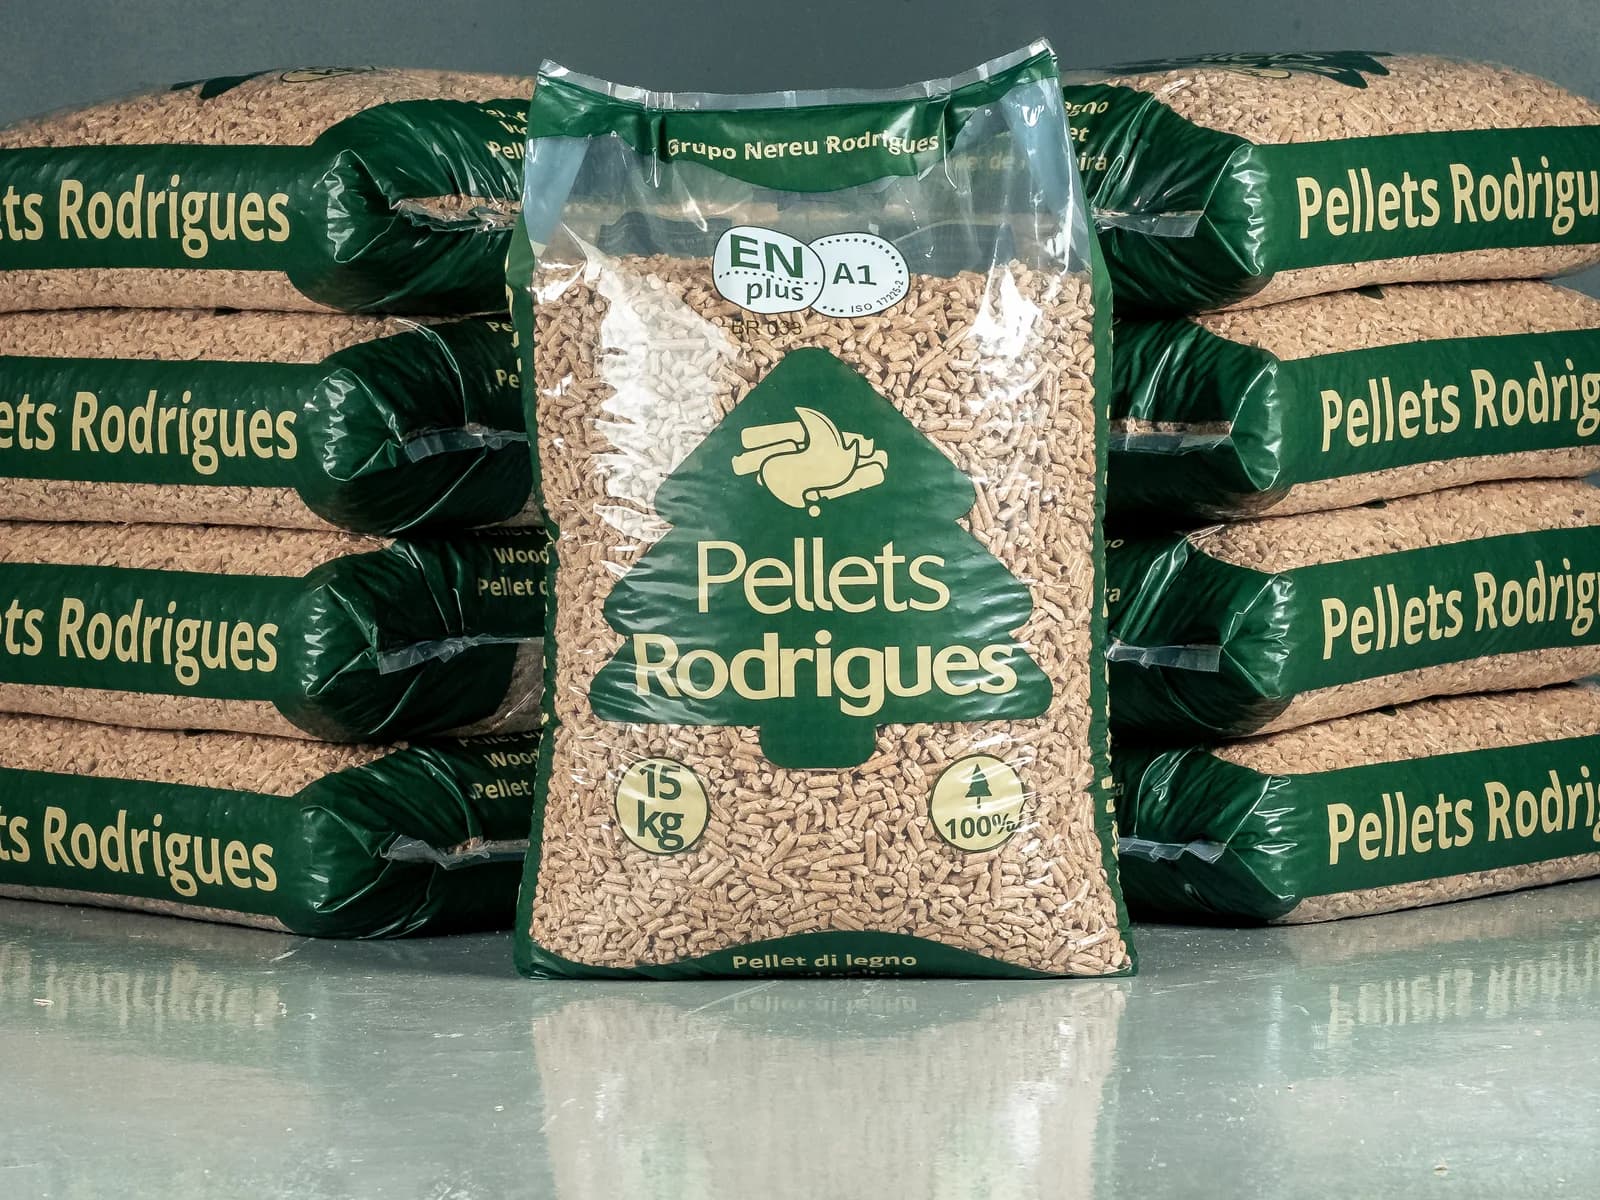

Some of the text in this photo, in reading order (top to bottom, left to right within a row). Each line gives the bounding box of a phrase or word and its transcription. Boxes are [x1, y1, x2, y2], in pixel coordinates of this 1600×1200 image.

[668, 131, 940, 160] Grupo Nereu Rodrigues
[0, 174, 290, 259] ts Rodrigues
[1296, 156, 1599, 239] Pellets Rodrigu
[730, 234, 804, 279] EN
[832, 262, 877, 286] A1
[746, 278, 804, 305] plus
[851, 303, 873, 313] ISO
[732, 320, 760, 335] BR
[1321, 359, 1600, 452] Pellets Rodrig
[0, 389, 298, 475] ets Rodrigues
[477, 577, 534, 596] Pellet
[697, 537, 951, 614] Pellets
[1322, 559, 1600, 660] Pellets Rodrig
[0, 598, 279, 686] ts Rodrigues
[633, 629, 1018, 717] Rodrigues
[639, 763, 682, 800] 15
[637, 799, 684, 851] kg
[944, 812, 1018, 840] 100%
[1328, 791, 1474, 865] Pellets
[43, 806, 277, 897] Rodrigues
[732, 953, 917, 969] Pellet di legno
